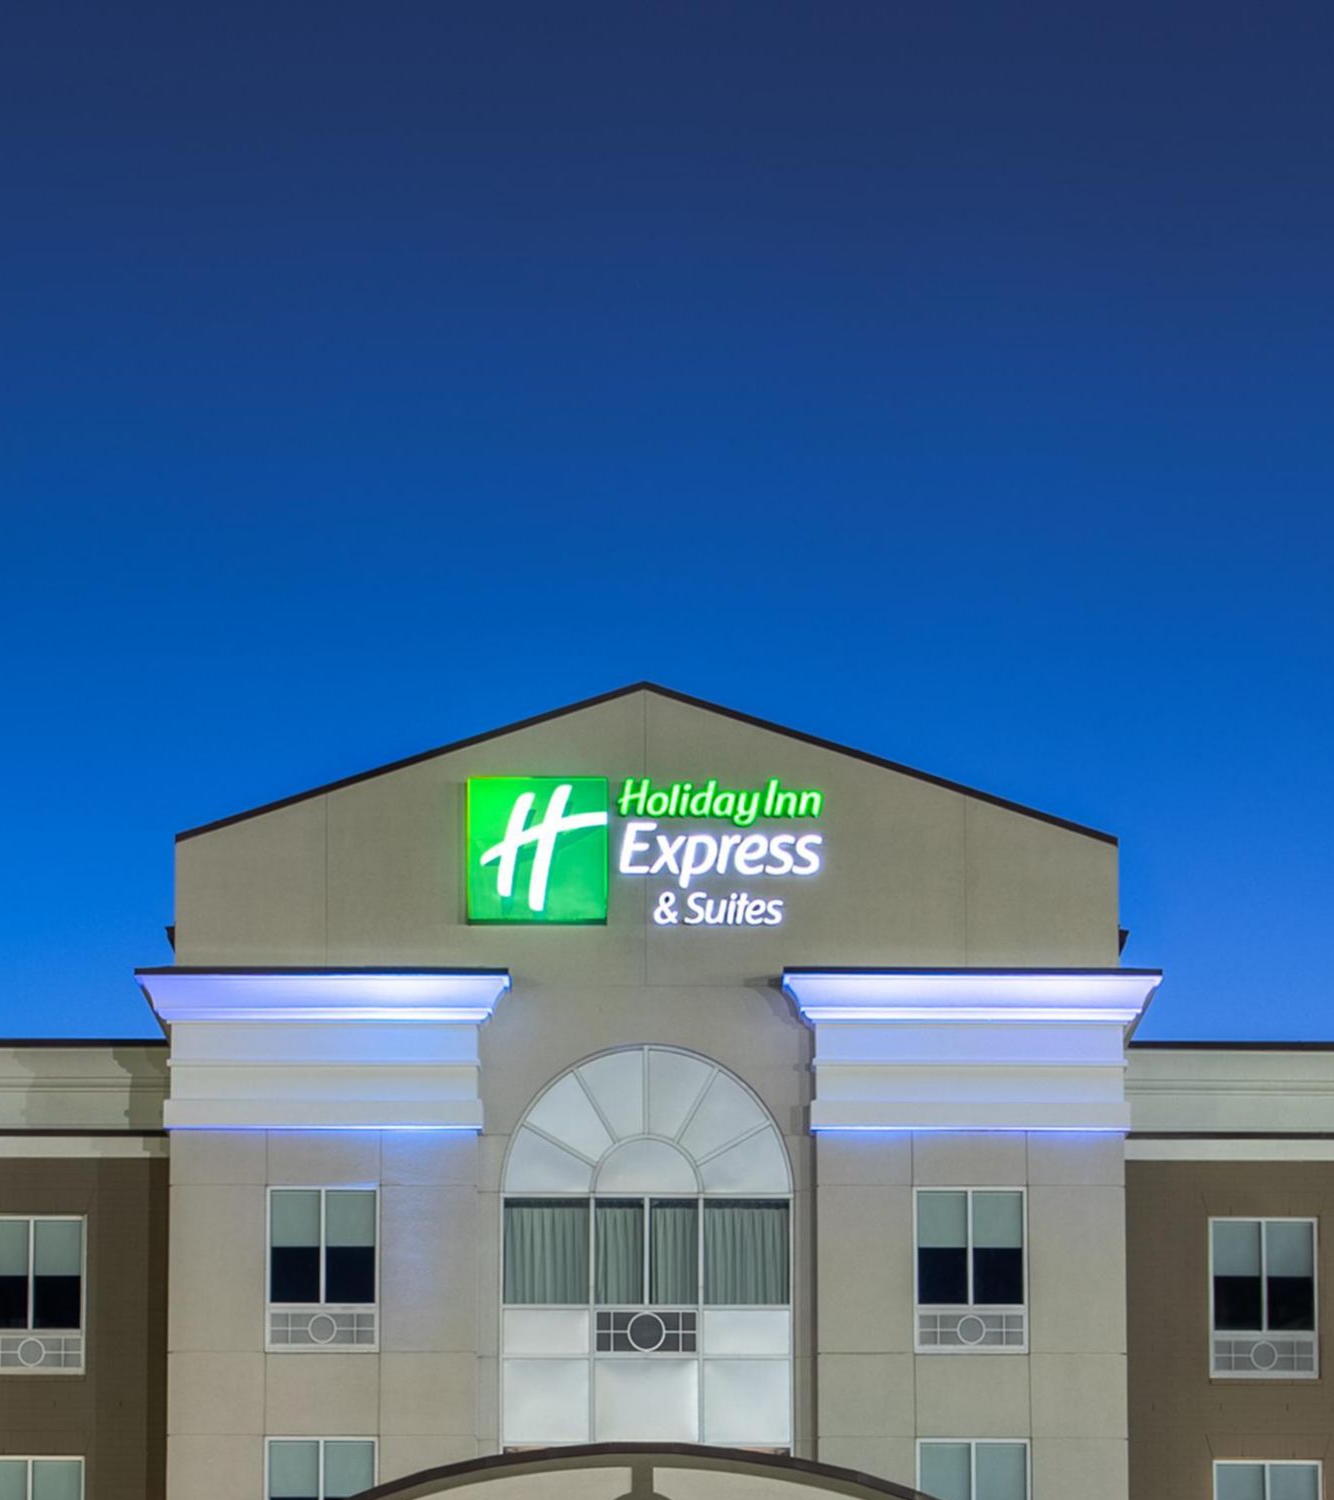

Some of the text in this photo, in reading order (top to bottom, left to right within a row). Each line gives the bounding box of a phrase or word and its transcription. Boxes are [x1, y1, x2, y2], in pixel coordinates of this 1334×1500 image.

[617, 778, 823, 826] Holiday Inn
[480, 784, 608, 912] H
[618, 821, 823, 889] Express
[653, 891, 785, 925] & Suites
